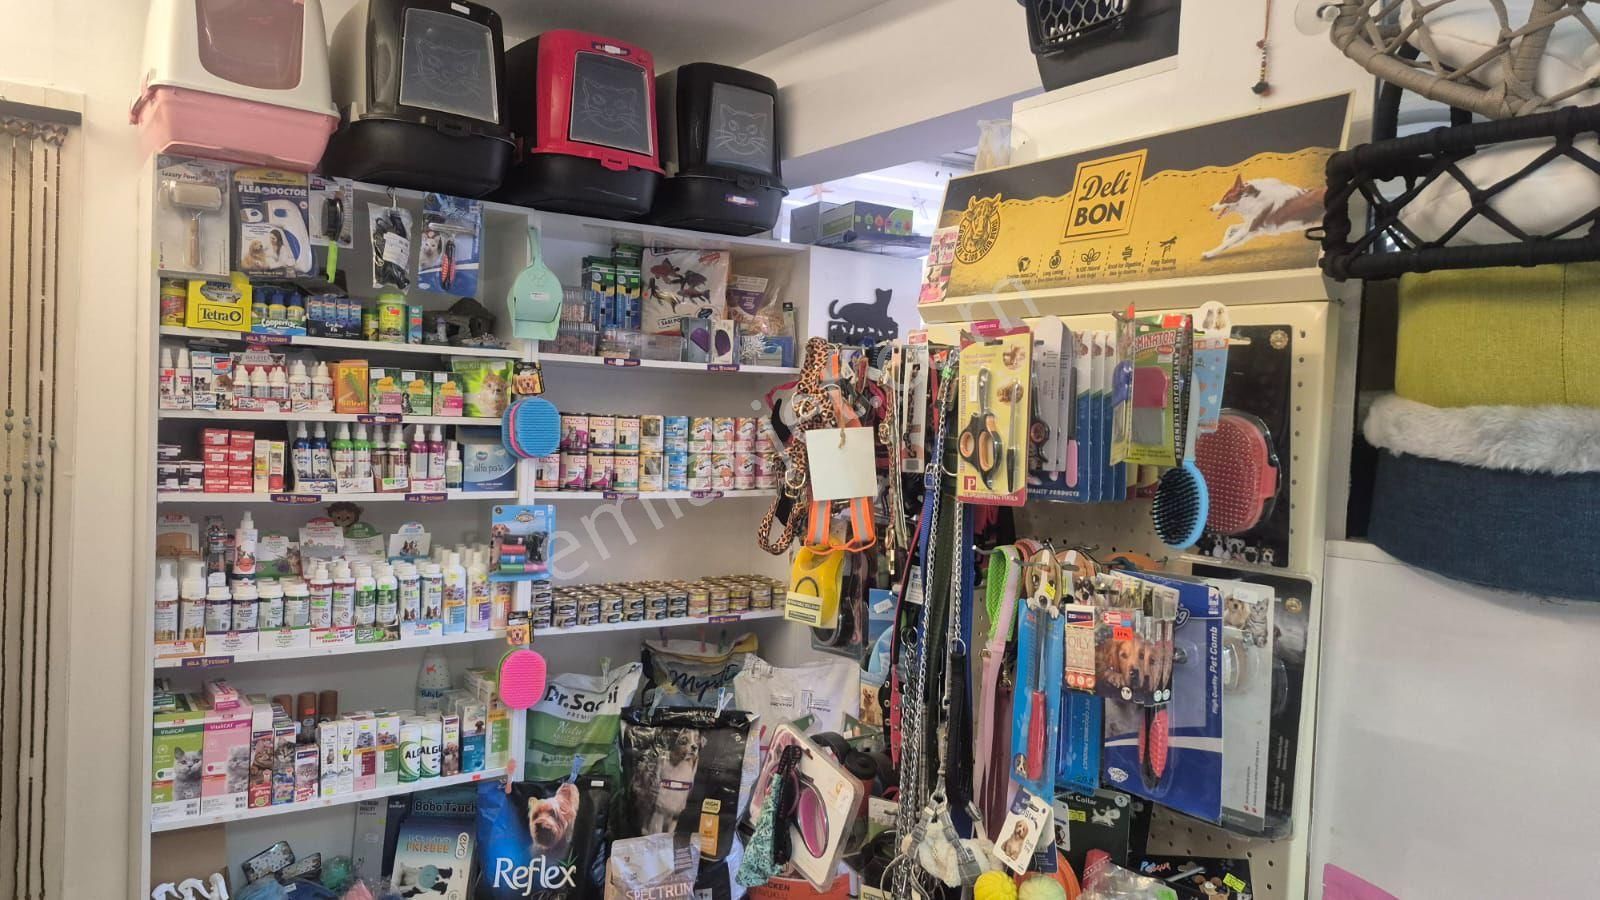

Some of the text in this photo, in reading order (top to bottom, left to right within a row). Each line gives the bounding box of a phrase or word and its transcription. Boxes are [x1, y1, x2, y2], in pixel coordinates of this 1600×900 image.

[238, 184, 308, 197] FLEA DOCTOR
[1078, 169, 1131, 203] Deli
[1074, 200, 1125, 228] BON
[200, 307, 229, 322] Tetra
[1209, 626, 1218, 655] Comb
[1209, 656, 1218, 677] Pet
[415, 800, 442, 811] Bobo
[1075, 795, 1097, 805] Collar
[492, 854, 577, 897] Reflex
[626, 882, 694, 898] SPECTRUM
